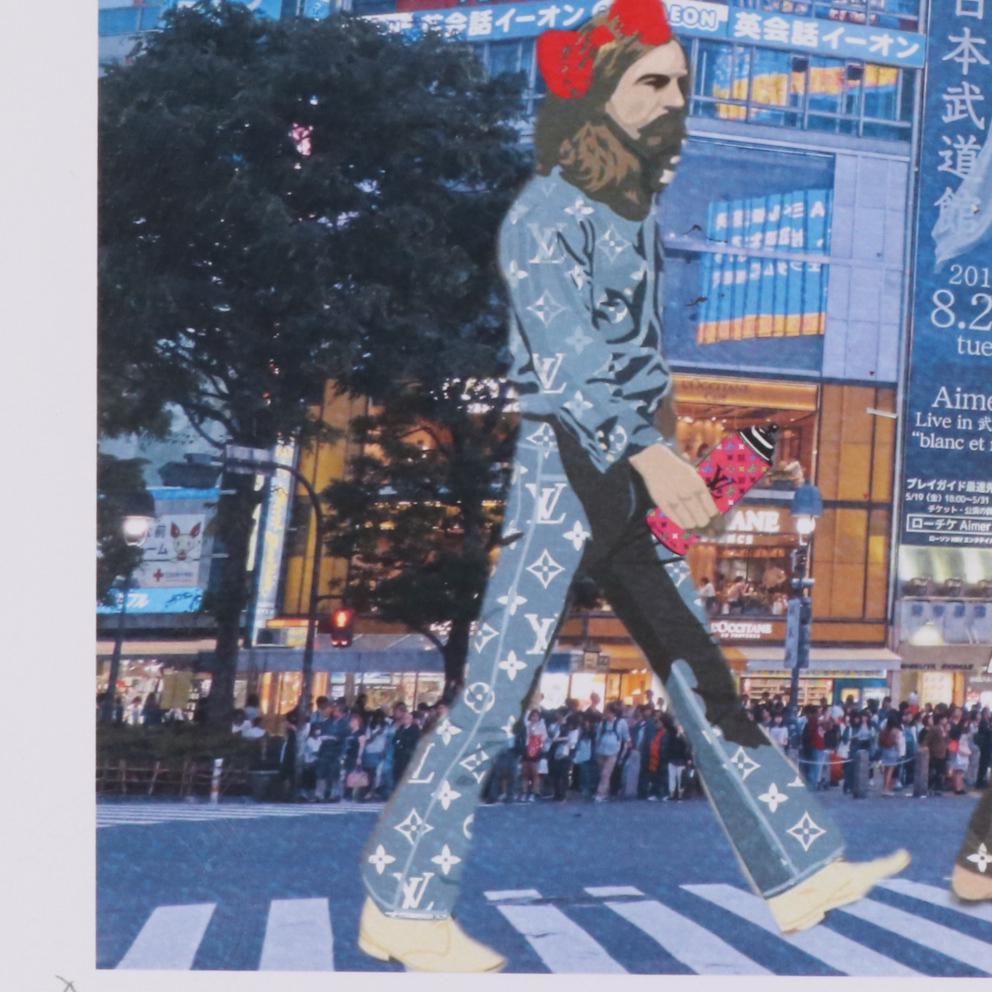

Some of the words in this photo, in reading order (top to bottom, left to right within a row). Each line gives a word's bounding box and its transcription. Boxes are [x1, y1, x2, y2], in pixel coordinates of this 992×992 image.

[668, 4, 719, 30] EON
[734, 11, 920, 59] 英会話イーオン
[915, 412, 953, 429] Live
[957, 414, 973, 430] in
[969, 439, 985, 452] et
[911, 518, 957, 530] ローチケ
[960, 519, 992, 532] Aimer
